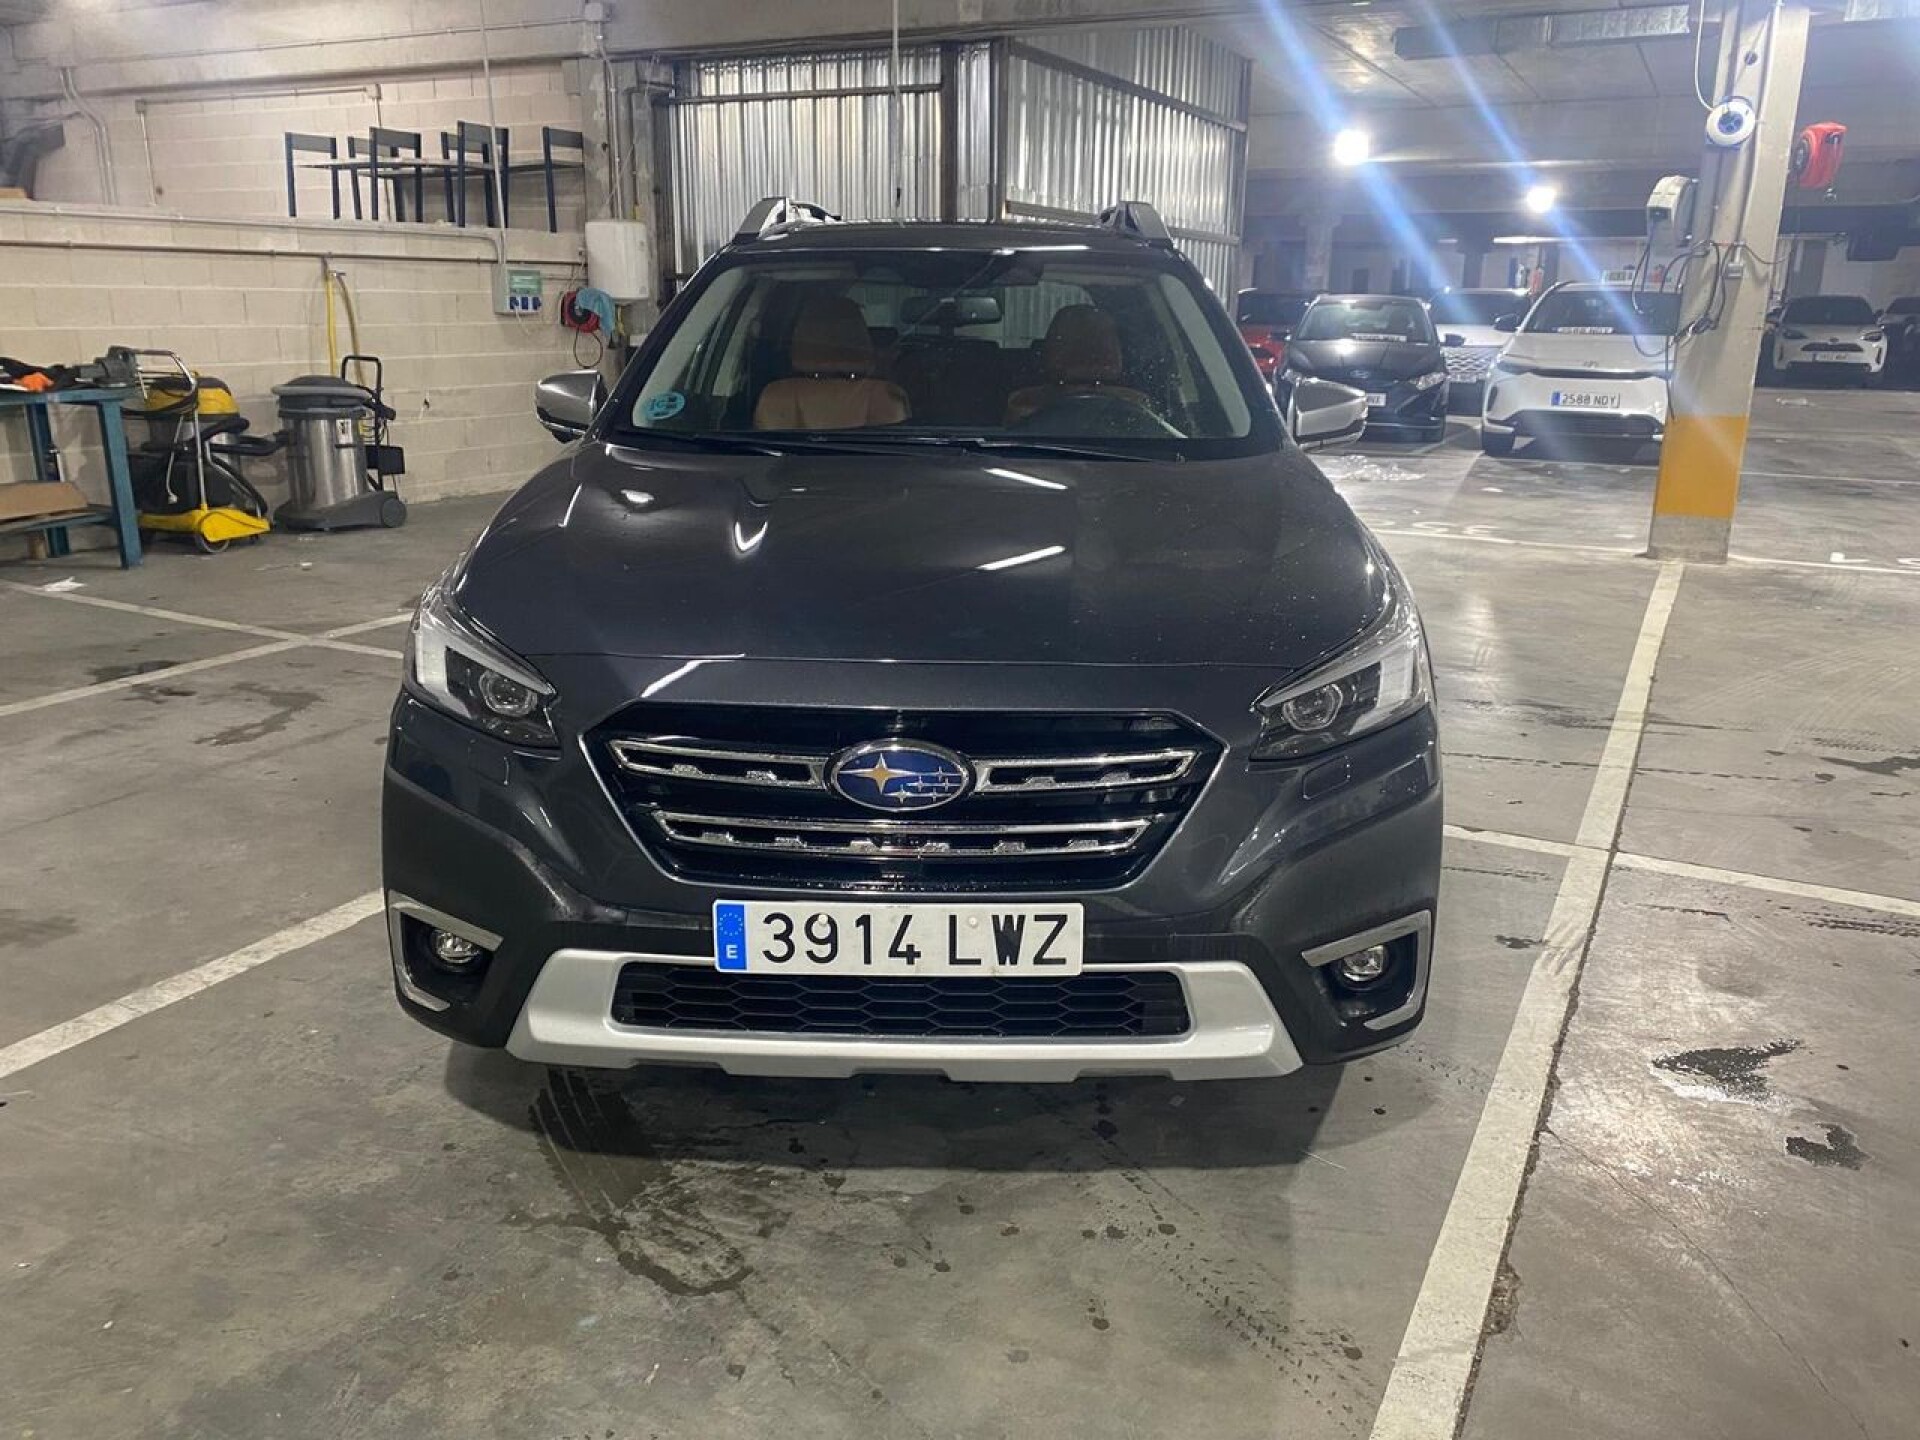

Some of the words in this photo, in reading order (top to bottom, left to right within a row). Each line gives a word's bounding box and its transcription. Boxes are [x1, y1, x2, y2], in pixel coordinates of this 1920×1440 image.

[1594, 395, 1616, 406] NDY
[726, 944, 738, 959] E
[762, 912, 922, 965] 3914
[948, 914, 1068, 966] LWZ
